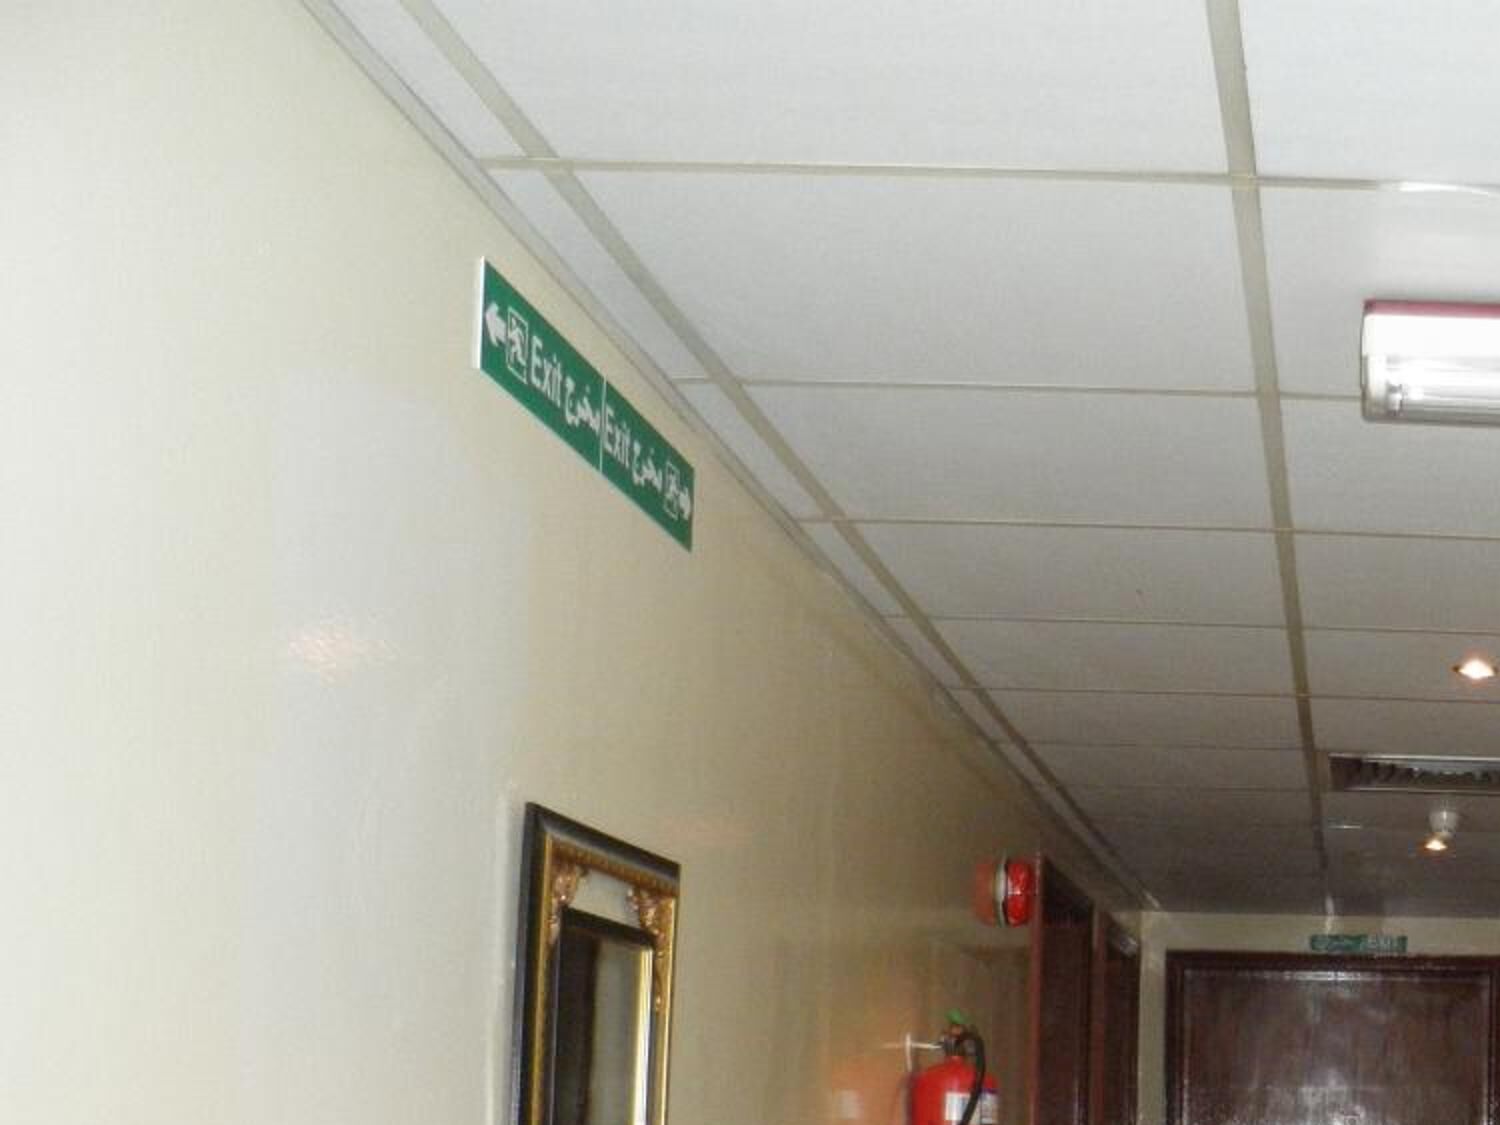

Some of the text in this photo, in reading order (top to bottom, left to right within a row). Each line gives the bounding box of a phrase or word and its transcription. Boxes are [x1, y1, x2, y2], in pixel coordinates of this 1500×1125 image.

[531, 335, 561, 408] Exit
[565, 377, 601, 438] مخرج
[603, 405, 631, 468] Exit
[632, 442, 662, 493] مخرج
